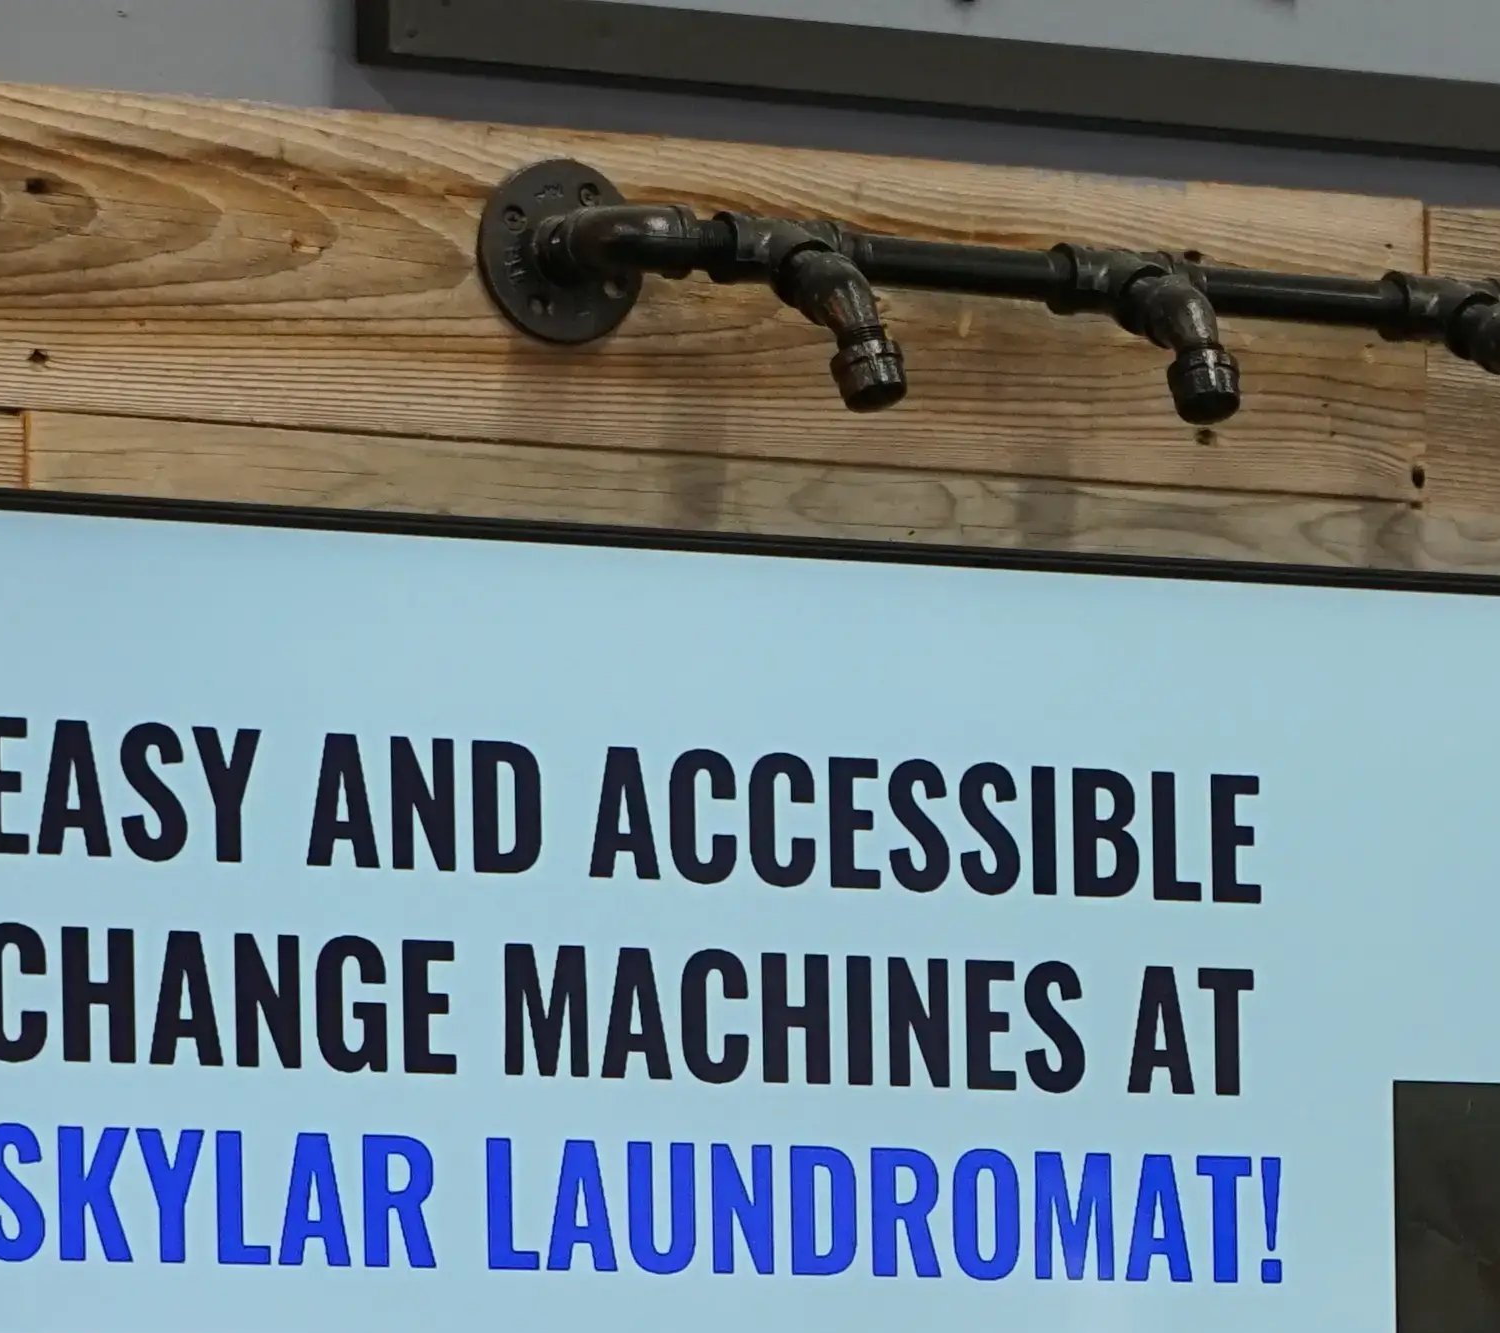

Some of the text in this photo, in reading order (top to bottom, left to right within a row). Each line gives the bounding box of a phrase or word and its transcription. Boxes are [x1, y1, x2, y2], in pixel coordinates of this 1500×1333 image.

[307, 733, 541, 873] AND
[589, 747, 1261, 904] ACCESSIBLE
[505, 944, 1085, 1093] MACHINES
[1128, 966, 1253, 1095] AT
[486, 1138, 1282, 1283] LAUNDROMAT!
